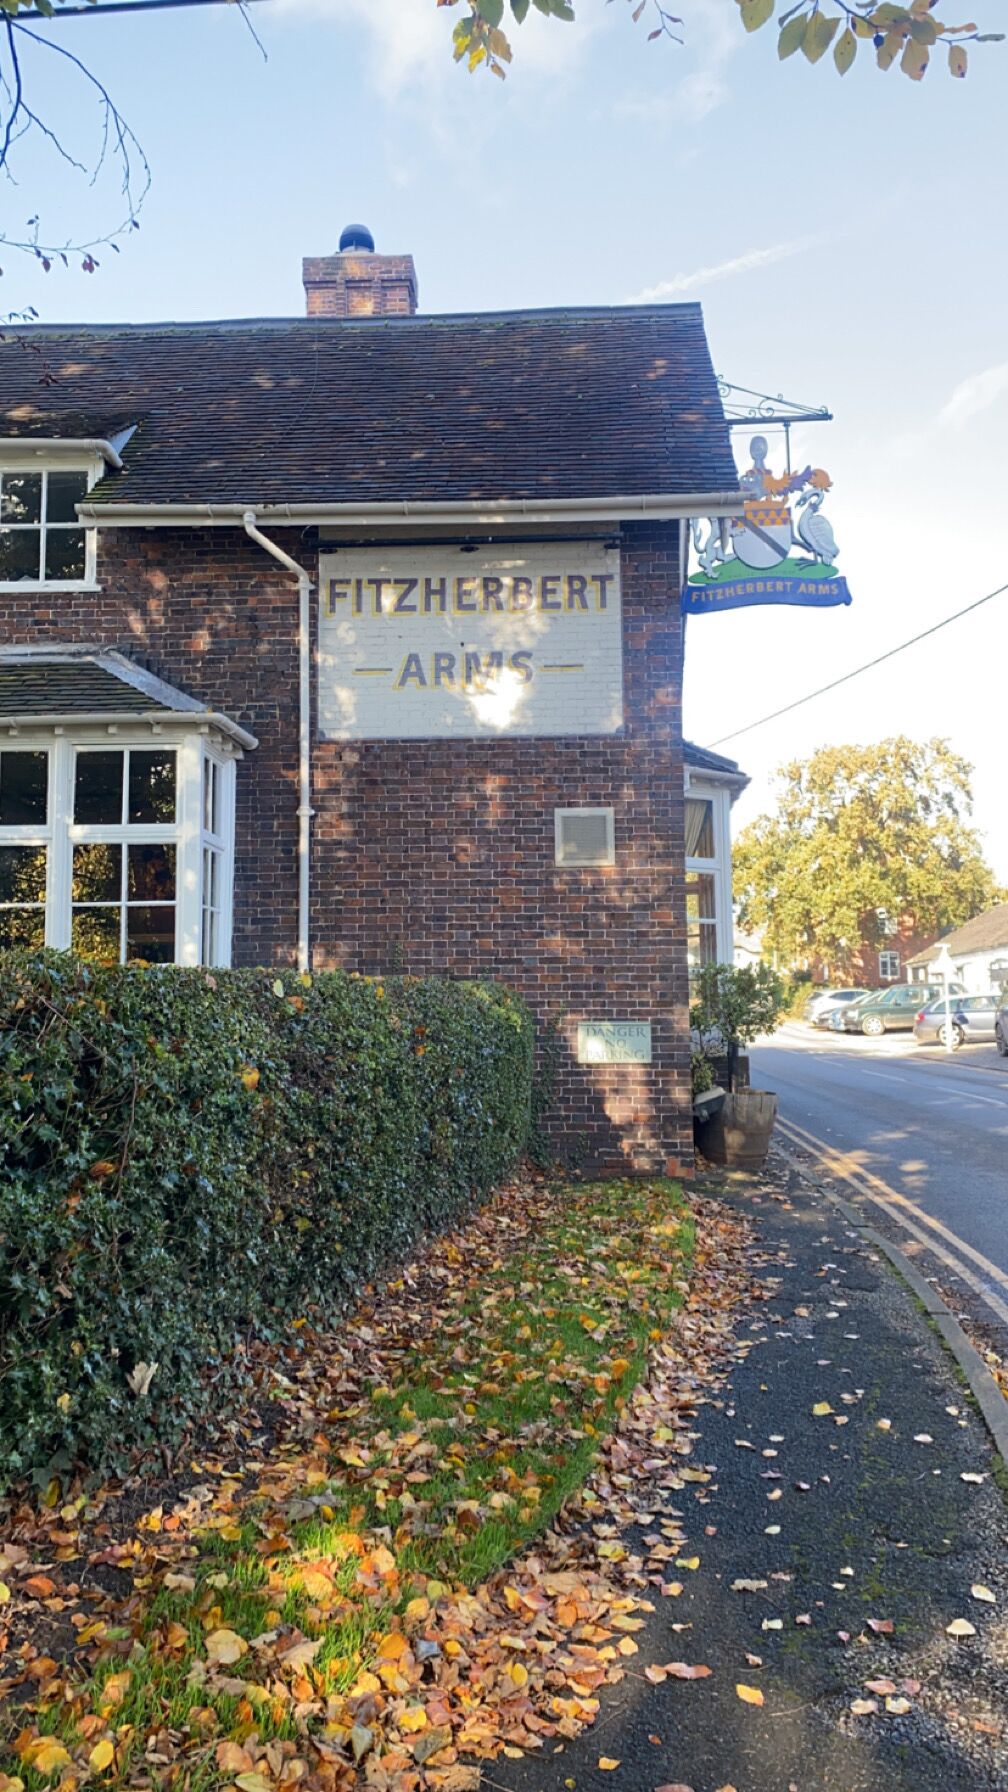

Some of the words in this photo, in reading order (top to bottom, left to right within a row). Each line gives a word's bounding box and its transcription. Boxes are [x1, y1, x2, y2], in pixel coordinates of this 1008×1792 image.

[324, 574, 615, 618] FITZHERBERT
[691, 581, 793, 602] FITZHERBERT
[797, 582, 839, 595] ARMS
[393, 650, 534, 690] ARMS
[586, 1026, 647, 1039] DANGER
